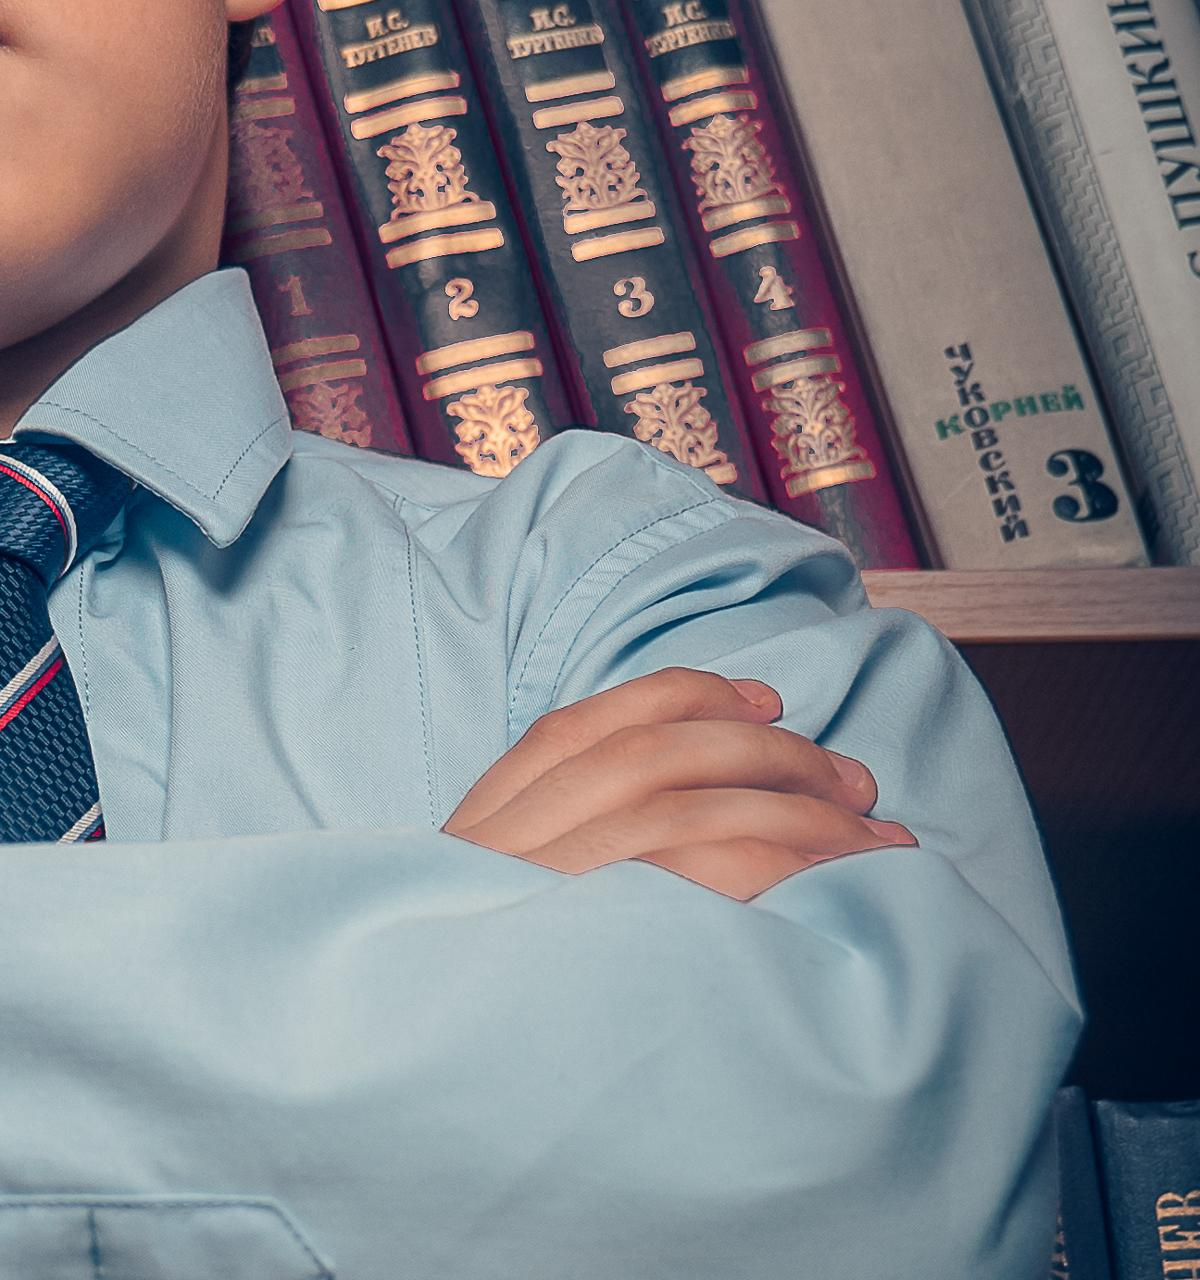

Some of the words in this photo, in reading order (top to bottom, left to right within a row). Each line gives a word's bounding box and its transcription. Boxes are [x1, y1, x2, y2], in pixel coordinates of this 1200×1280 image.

[277, 275, 313, 316] 1
[443, 277, 480, 320] 2
[612, 276, 655, 319] 3
[753, 265, 794, 311] 4
[933, 383, 1085, 441] КОРНЕЙ
[943, 341, 1030, 544] ЧУКОВСКИЙ
[1045, 448, 1119, 524] 3
